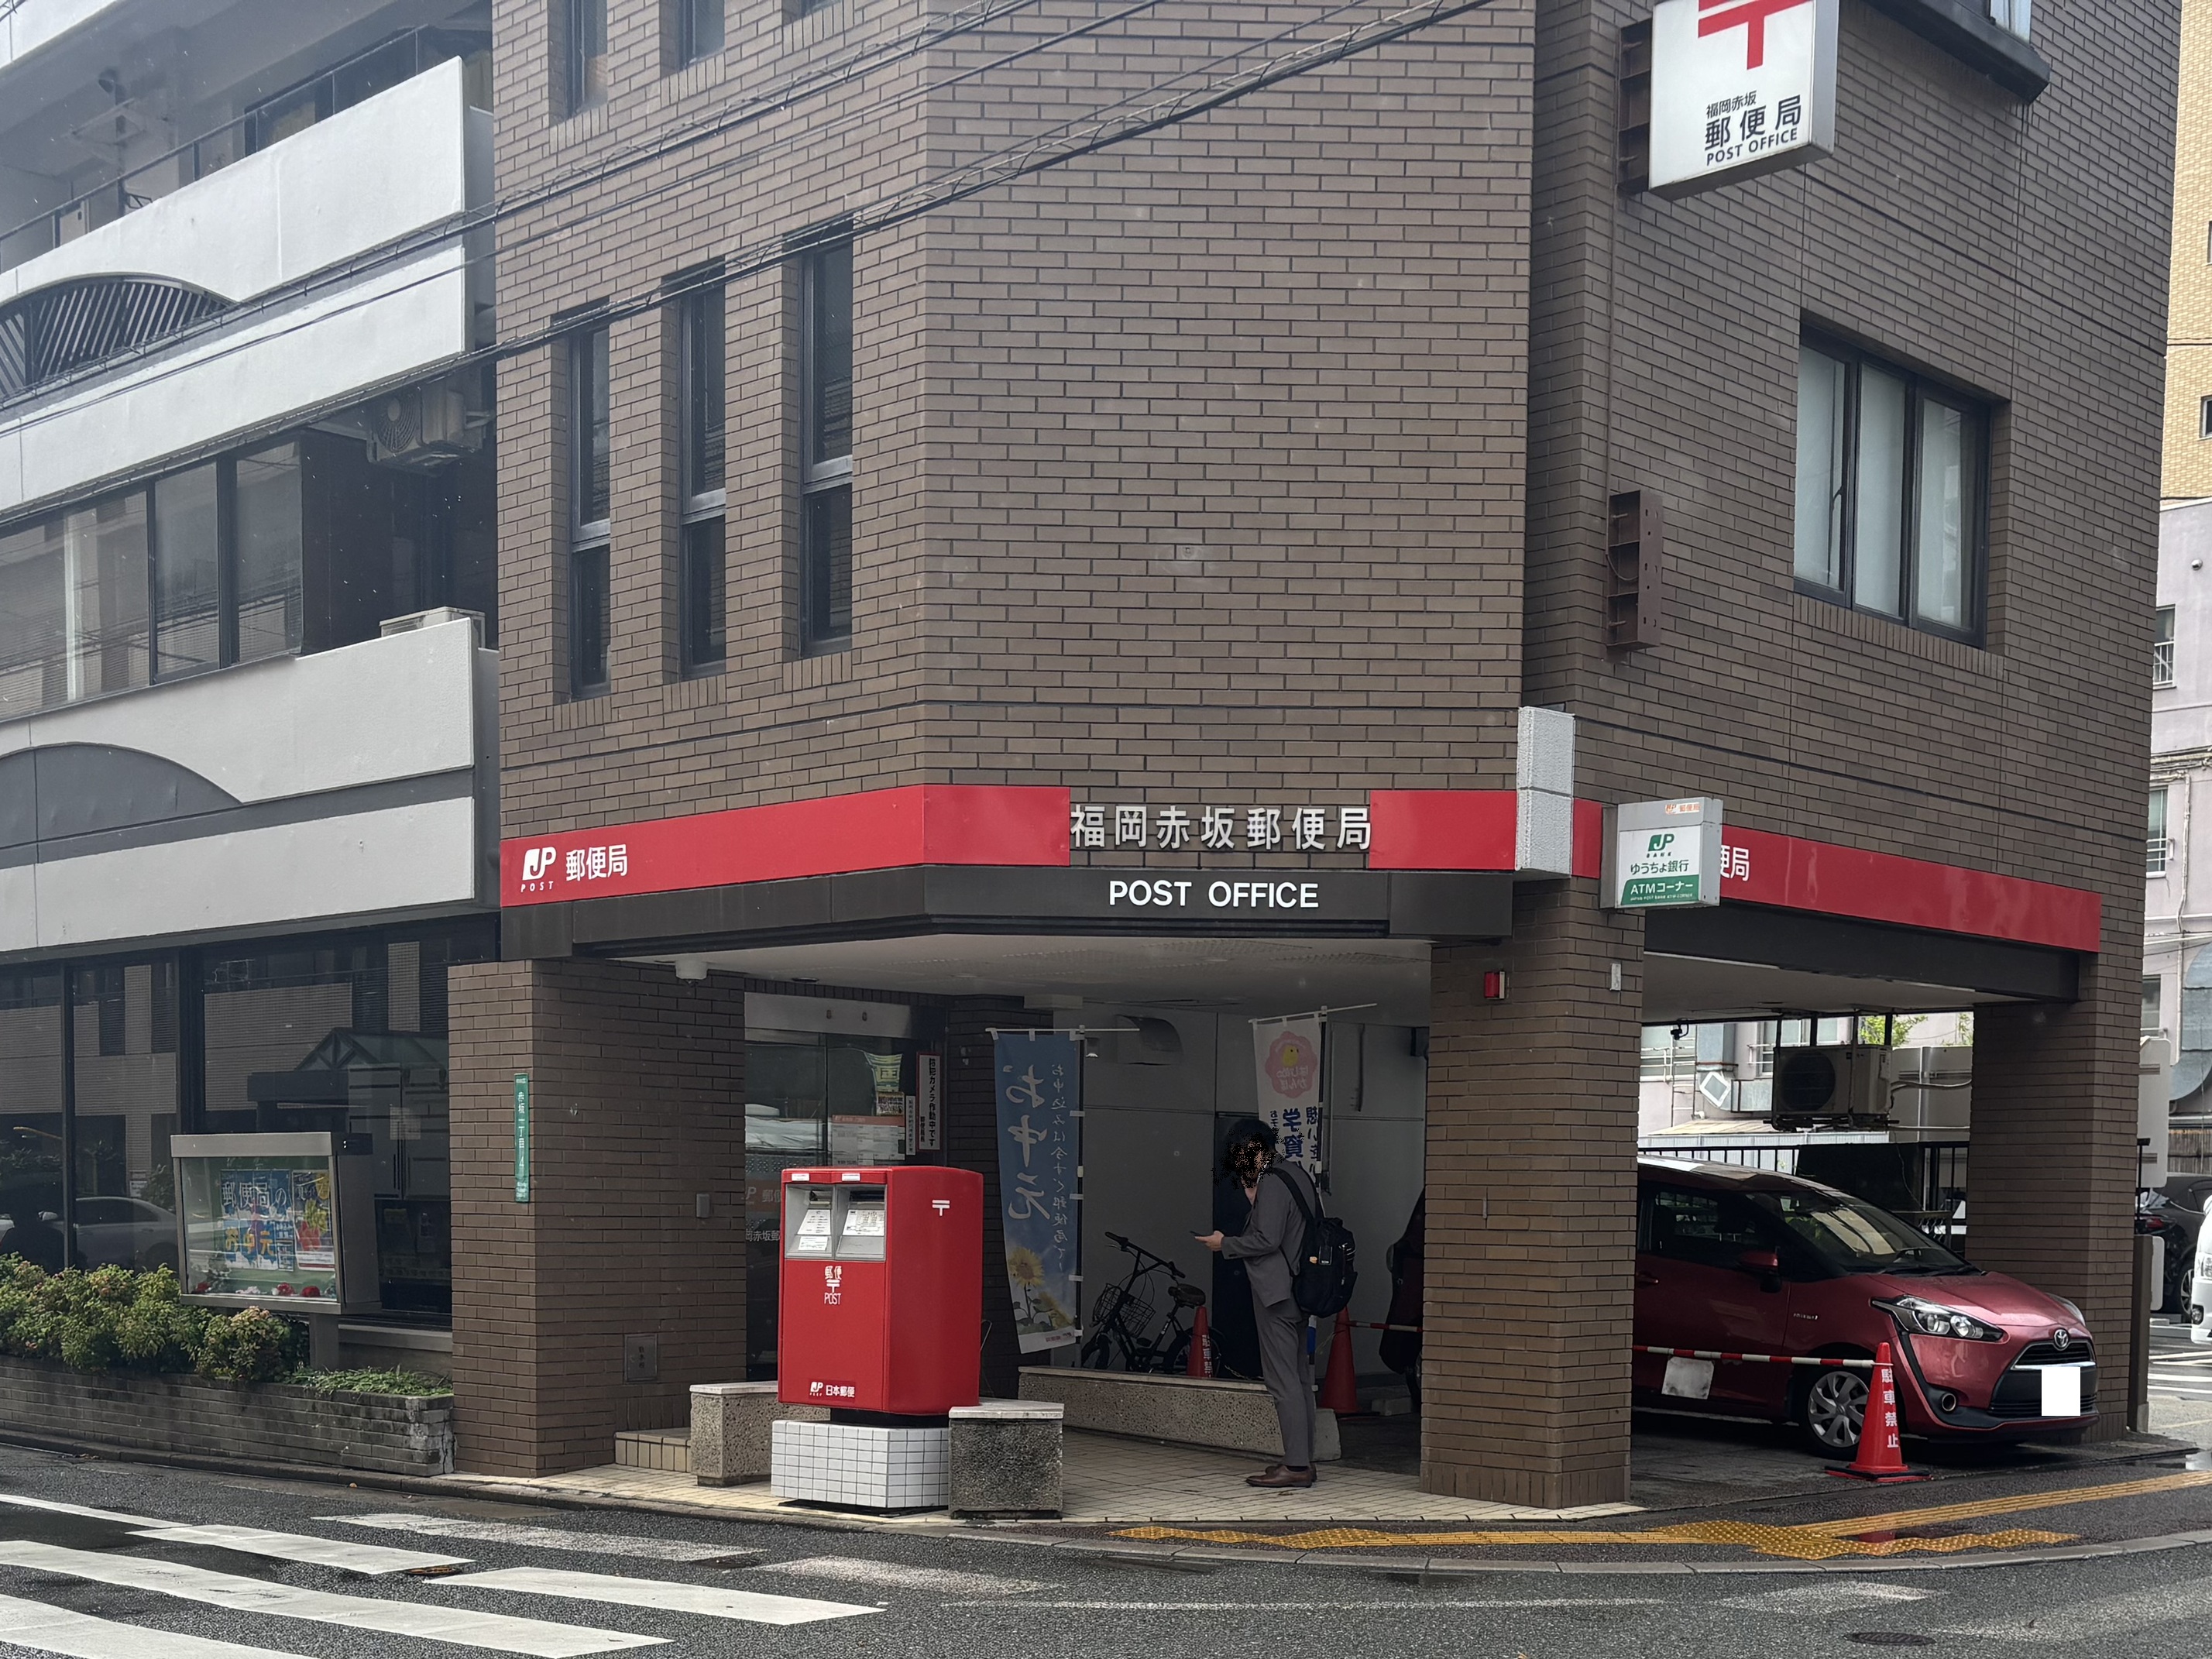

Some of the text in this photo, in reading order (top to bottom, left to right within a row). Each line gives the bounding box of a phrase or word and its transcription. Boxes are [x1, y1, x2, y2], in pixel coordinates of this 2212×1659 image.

[1706, 90, 1757, 118] 福岡赤坂
[1705, 94, 1802, 151] 郵便局
[1706, 127, 1798, 166] POST OFFICE
[1070, 804, 1371, 850] 福岡赤坂郵便局
[1648, 833, 1674, 851] JP
[566, 844, 628, 881] 郵便局
[1630, 860, 1689, 875] ゆうちょ銀行
[520, 881, 554, 892] POST
[1109, 880, 1319, 908] POST OFFICE
[1630, 881, 1693, 895] ATMコーナー
[222, 1181, 287, 1209] 郵便局の
[825, 1266, 842, 1279] 郵便
[824, 1292, 841, 1304] POST
[826, 1385, 855, 1397] 日本郵便
[1881, 1369, 1899, 1448] 駐車禁止
